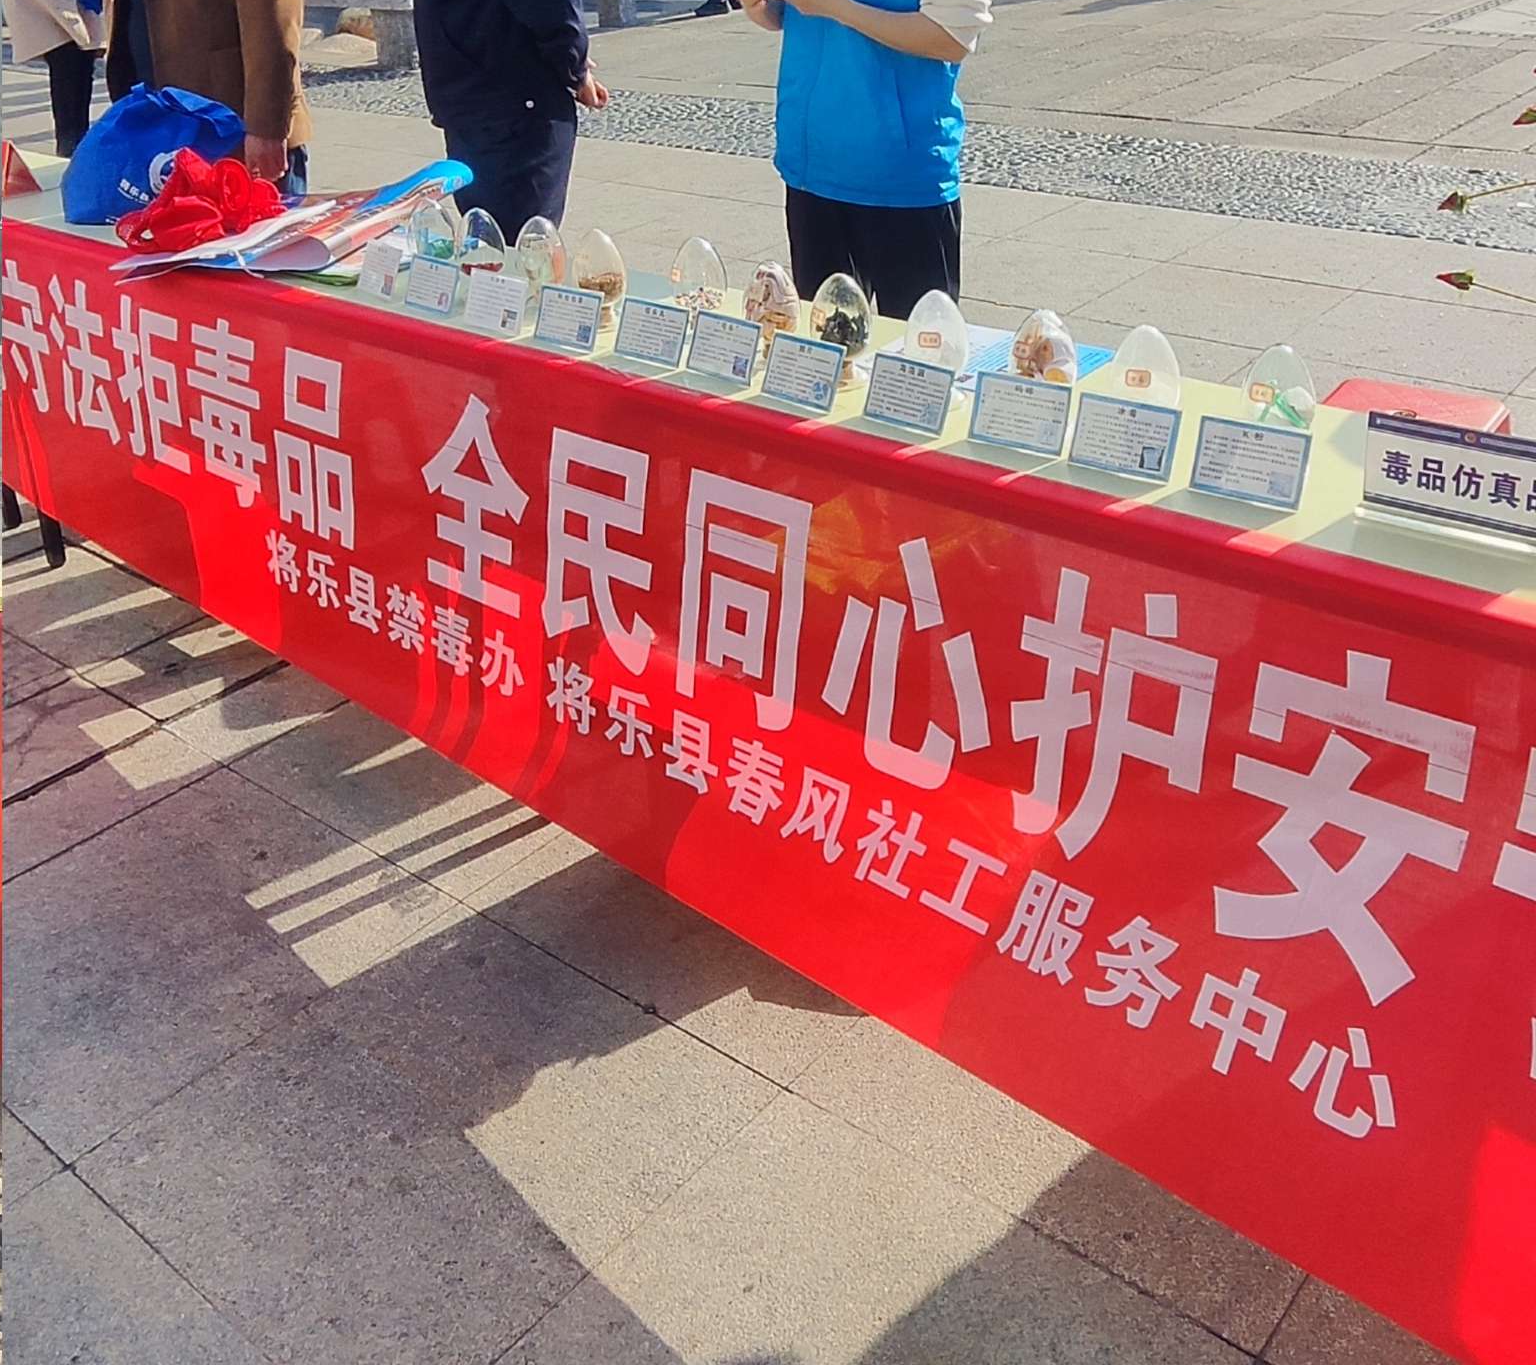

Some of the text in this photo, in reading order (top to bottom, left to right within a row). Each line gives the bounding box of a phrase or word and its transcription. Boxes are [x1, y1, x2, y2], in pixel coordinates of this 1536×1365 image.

[264, 529, 1398, 1141] 将乐县禁毒办 将乐县春风社工服务中心
